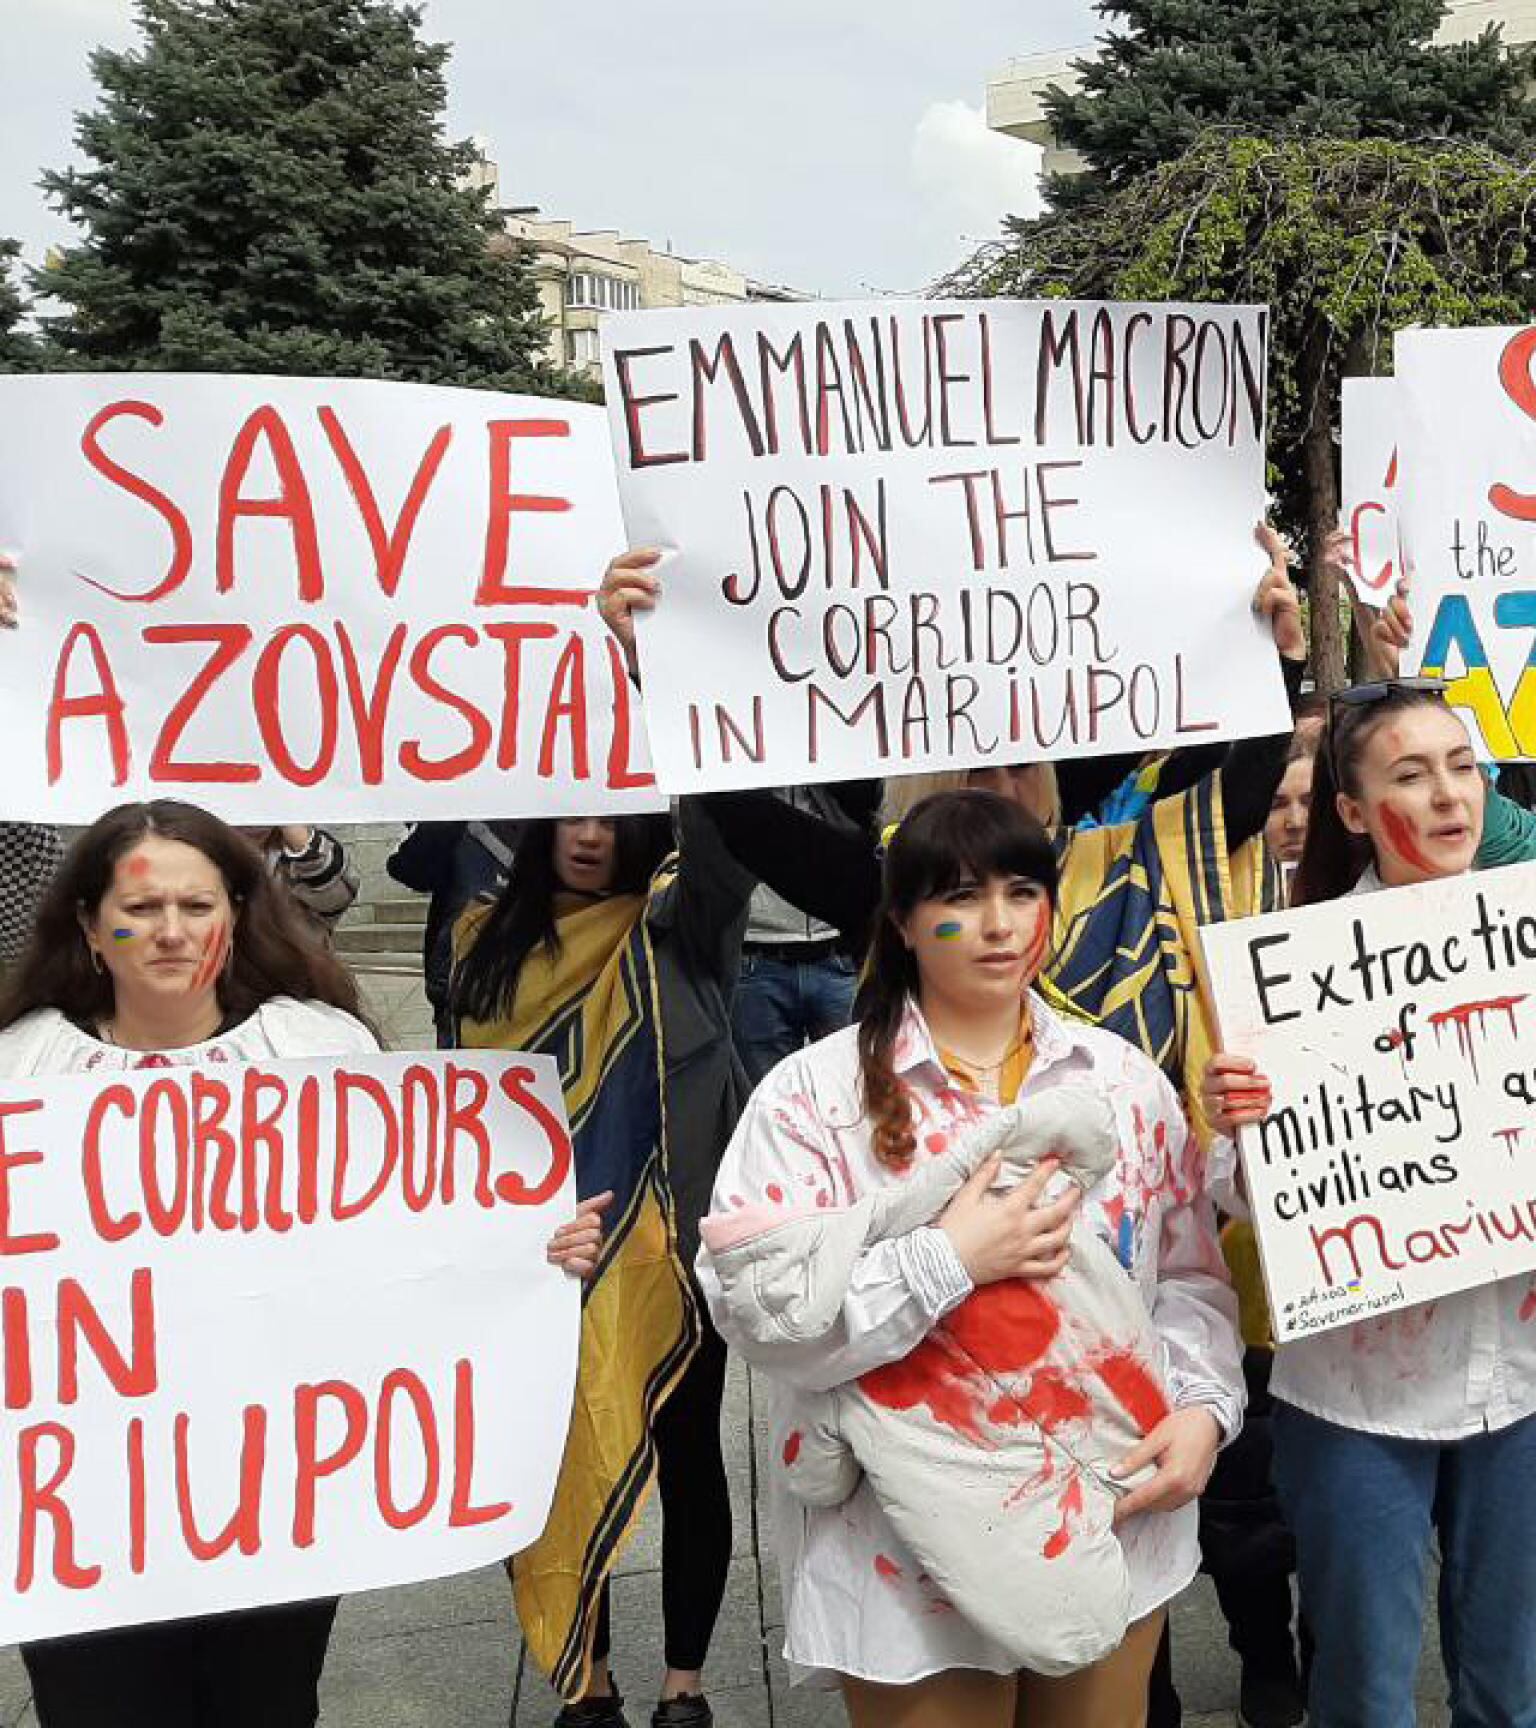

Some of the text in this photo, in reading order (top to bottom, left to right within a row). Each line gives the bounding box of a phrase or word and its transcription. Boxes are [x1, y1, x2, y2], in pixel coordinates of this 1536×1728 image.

[613, 307, 1268, 469] EMMANUEL MACRON
[72, 400, 600, 606] SAVE
[722, 460, 1096, 605] JOIN THE
[1450, 520, 1516, 579] the
[769, 582, 1119, 682] CORRIDOR
[46, 620, 655, 789] AZOVSTAL
[689, 695, 764, 768] IN
[1374, 1002, 1417, 1062] of
[81, 1062, 572, 1242] CORRIDORS
[1260, 1075, 1461, 1164] military
[1274, 1151, 1458, 1221] civilians
[2, 1267, 158, 1409] IN
[15, 1358, 513, 1593] RIUPOL
